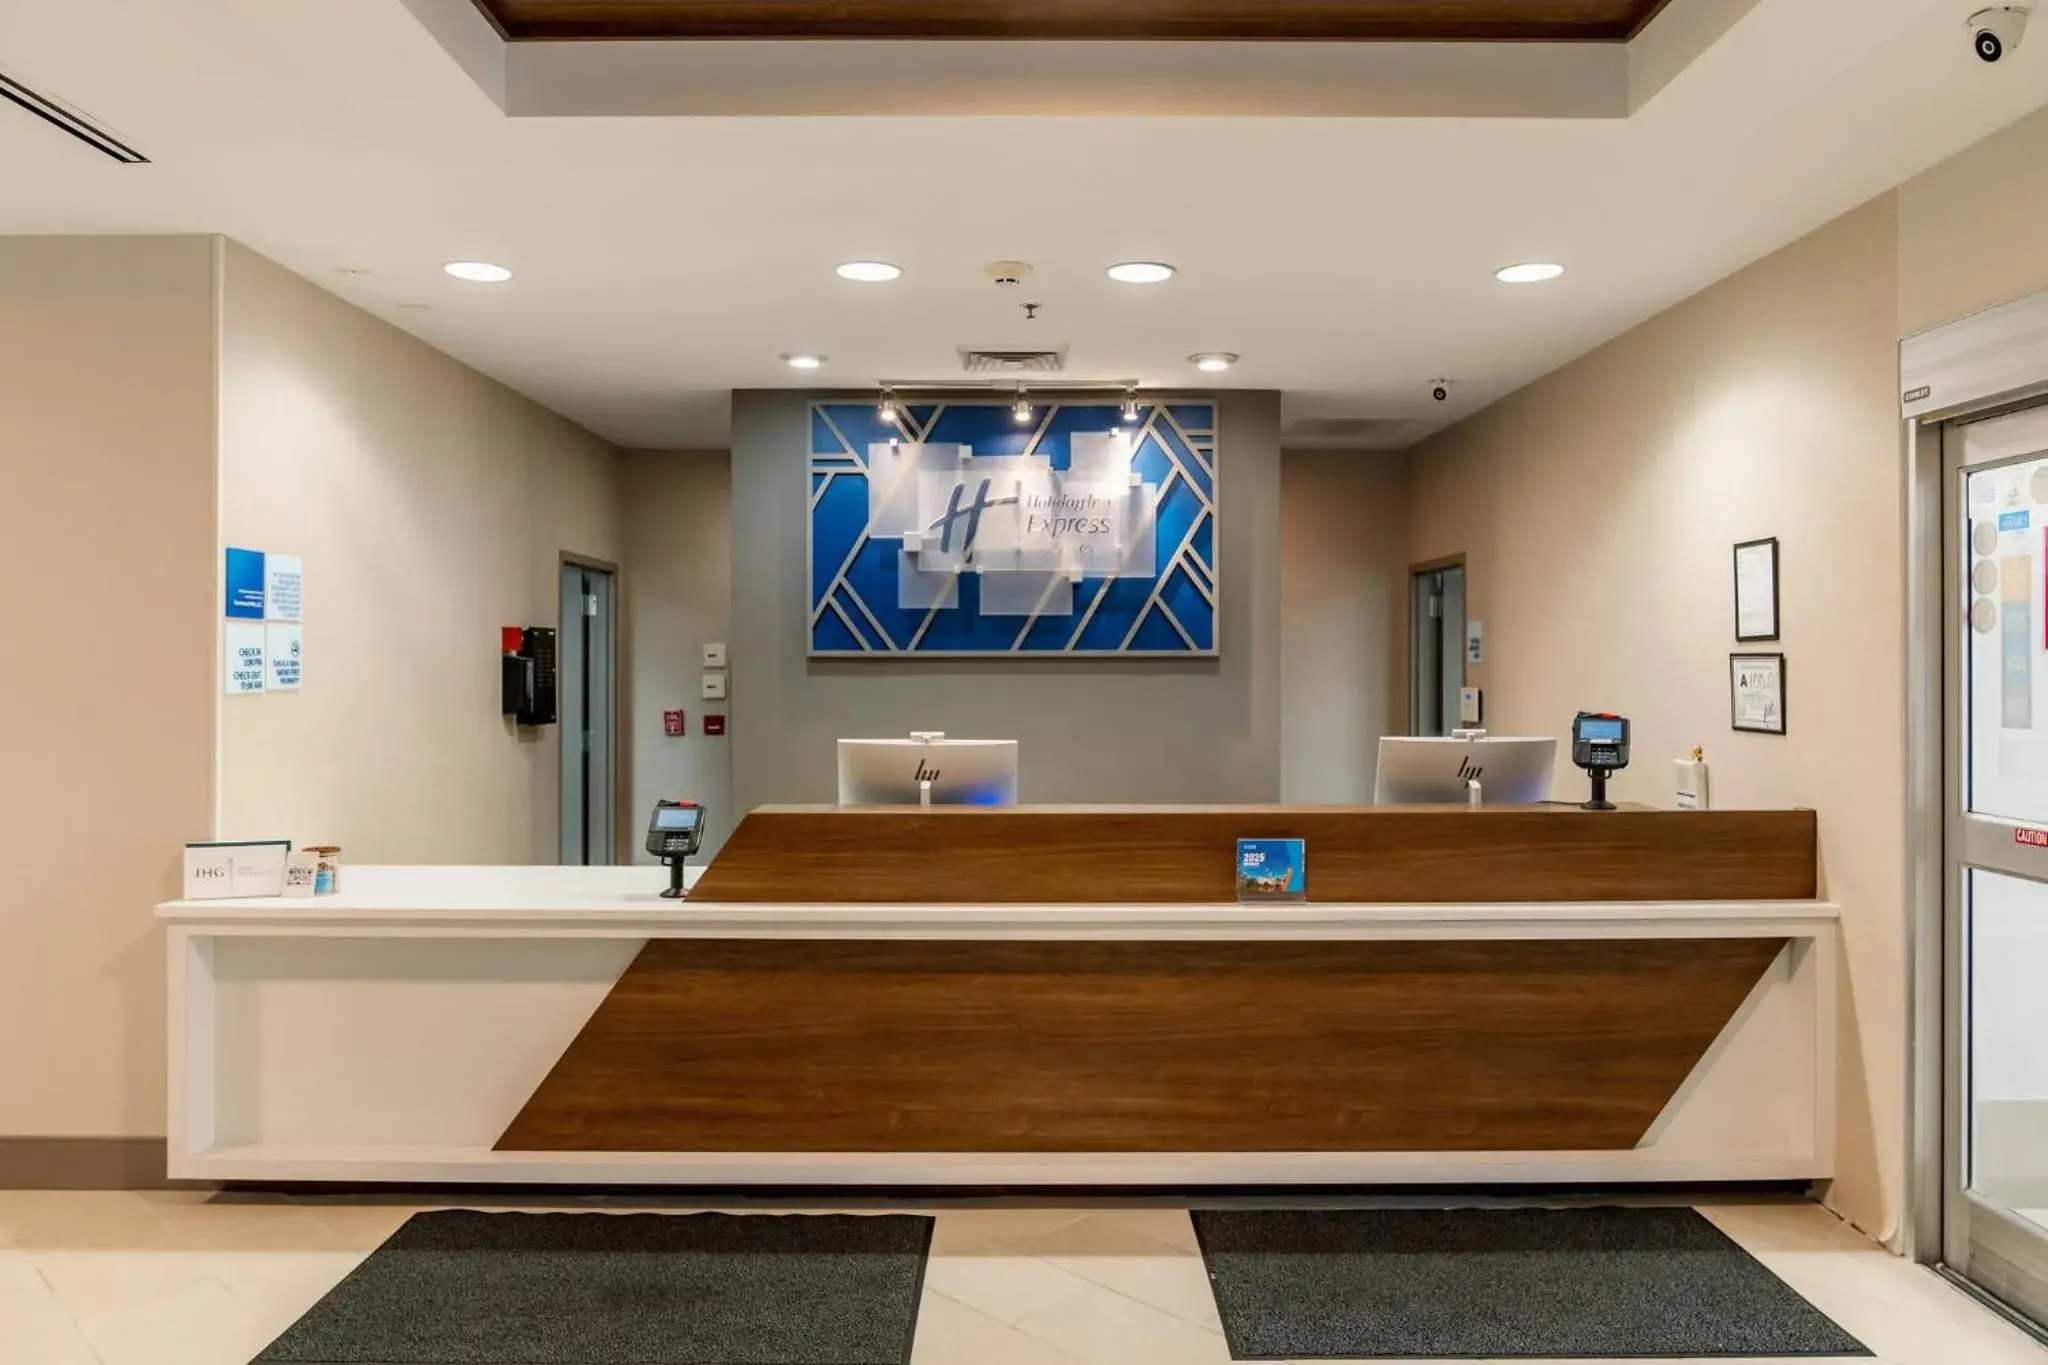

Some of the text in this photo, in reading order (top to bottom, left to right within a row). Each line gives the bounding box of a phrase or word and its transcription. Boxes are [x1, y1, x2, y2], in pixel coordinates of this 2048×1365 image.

[1027, 493, 1111, 512] Holiday Inn
[1027, 513, 1111, 538] Express
[1457, 755, 1483, 790] hp
[2017, 828, 2048, 846] CAUTION
[1243, 852, 1265, 863] 2025
[196, 868, 224, 879] IHG
